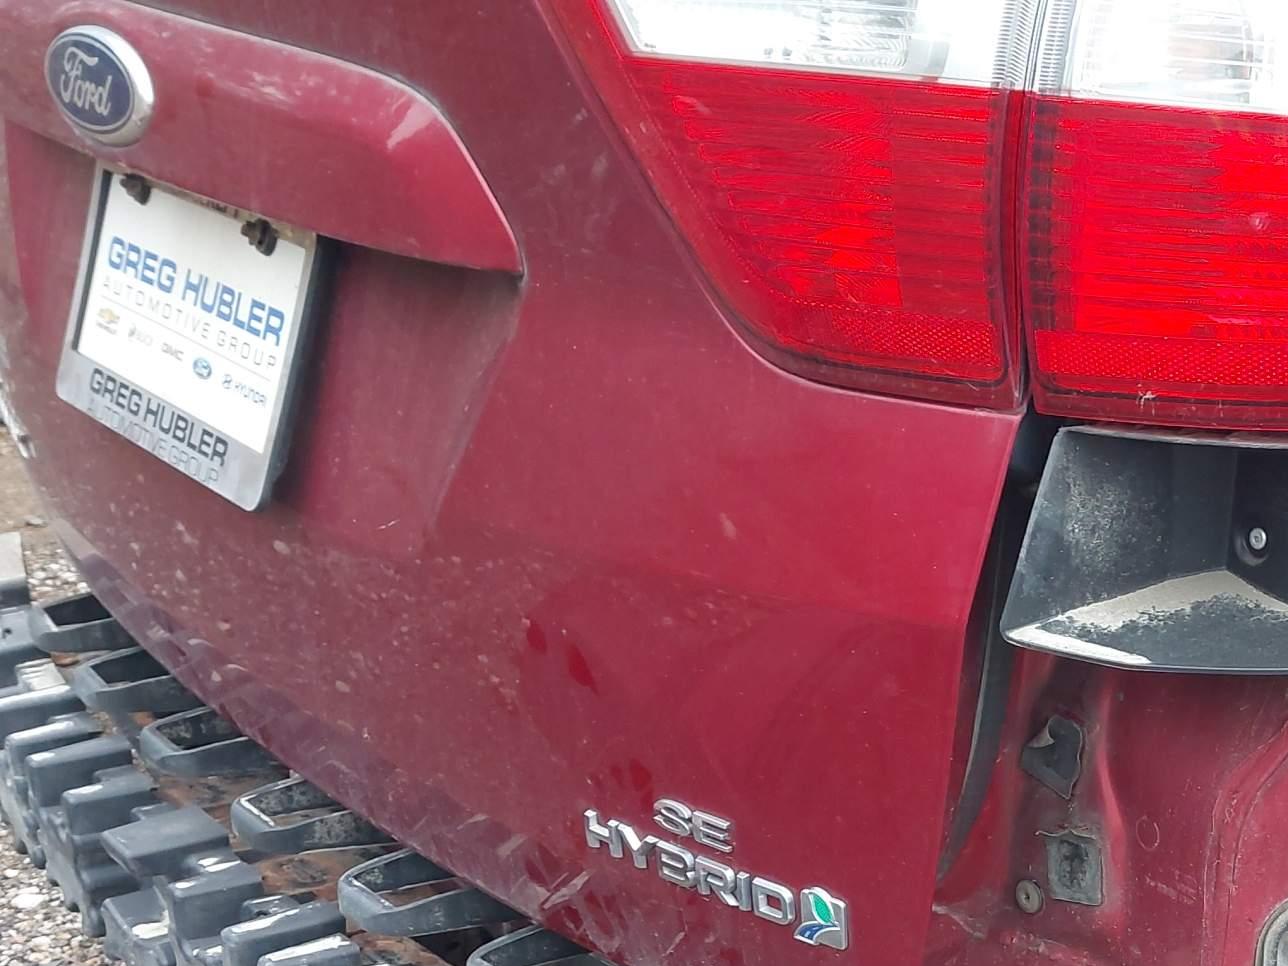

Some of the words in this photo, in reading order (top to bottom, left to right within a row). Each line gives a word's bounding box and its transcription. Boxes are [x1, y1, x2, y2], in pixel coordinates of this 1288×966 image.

[60, 46, 112, 116] Ford
[103, 275, 210, 341] AUTOMOTIVE
[216, 330, 277, 368] GROUP
[108, 236, 177, 294] GREG
[182, 268, 285, 346] HUBLER
[89, 368, 143, 416] GREG
[143, 398, 229, 466] HUBLER
[584, 808, 796, 925] HYBRID
[653, 798, 733, 853] SE
